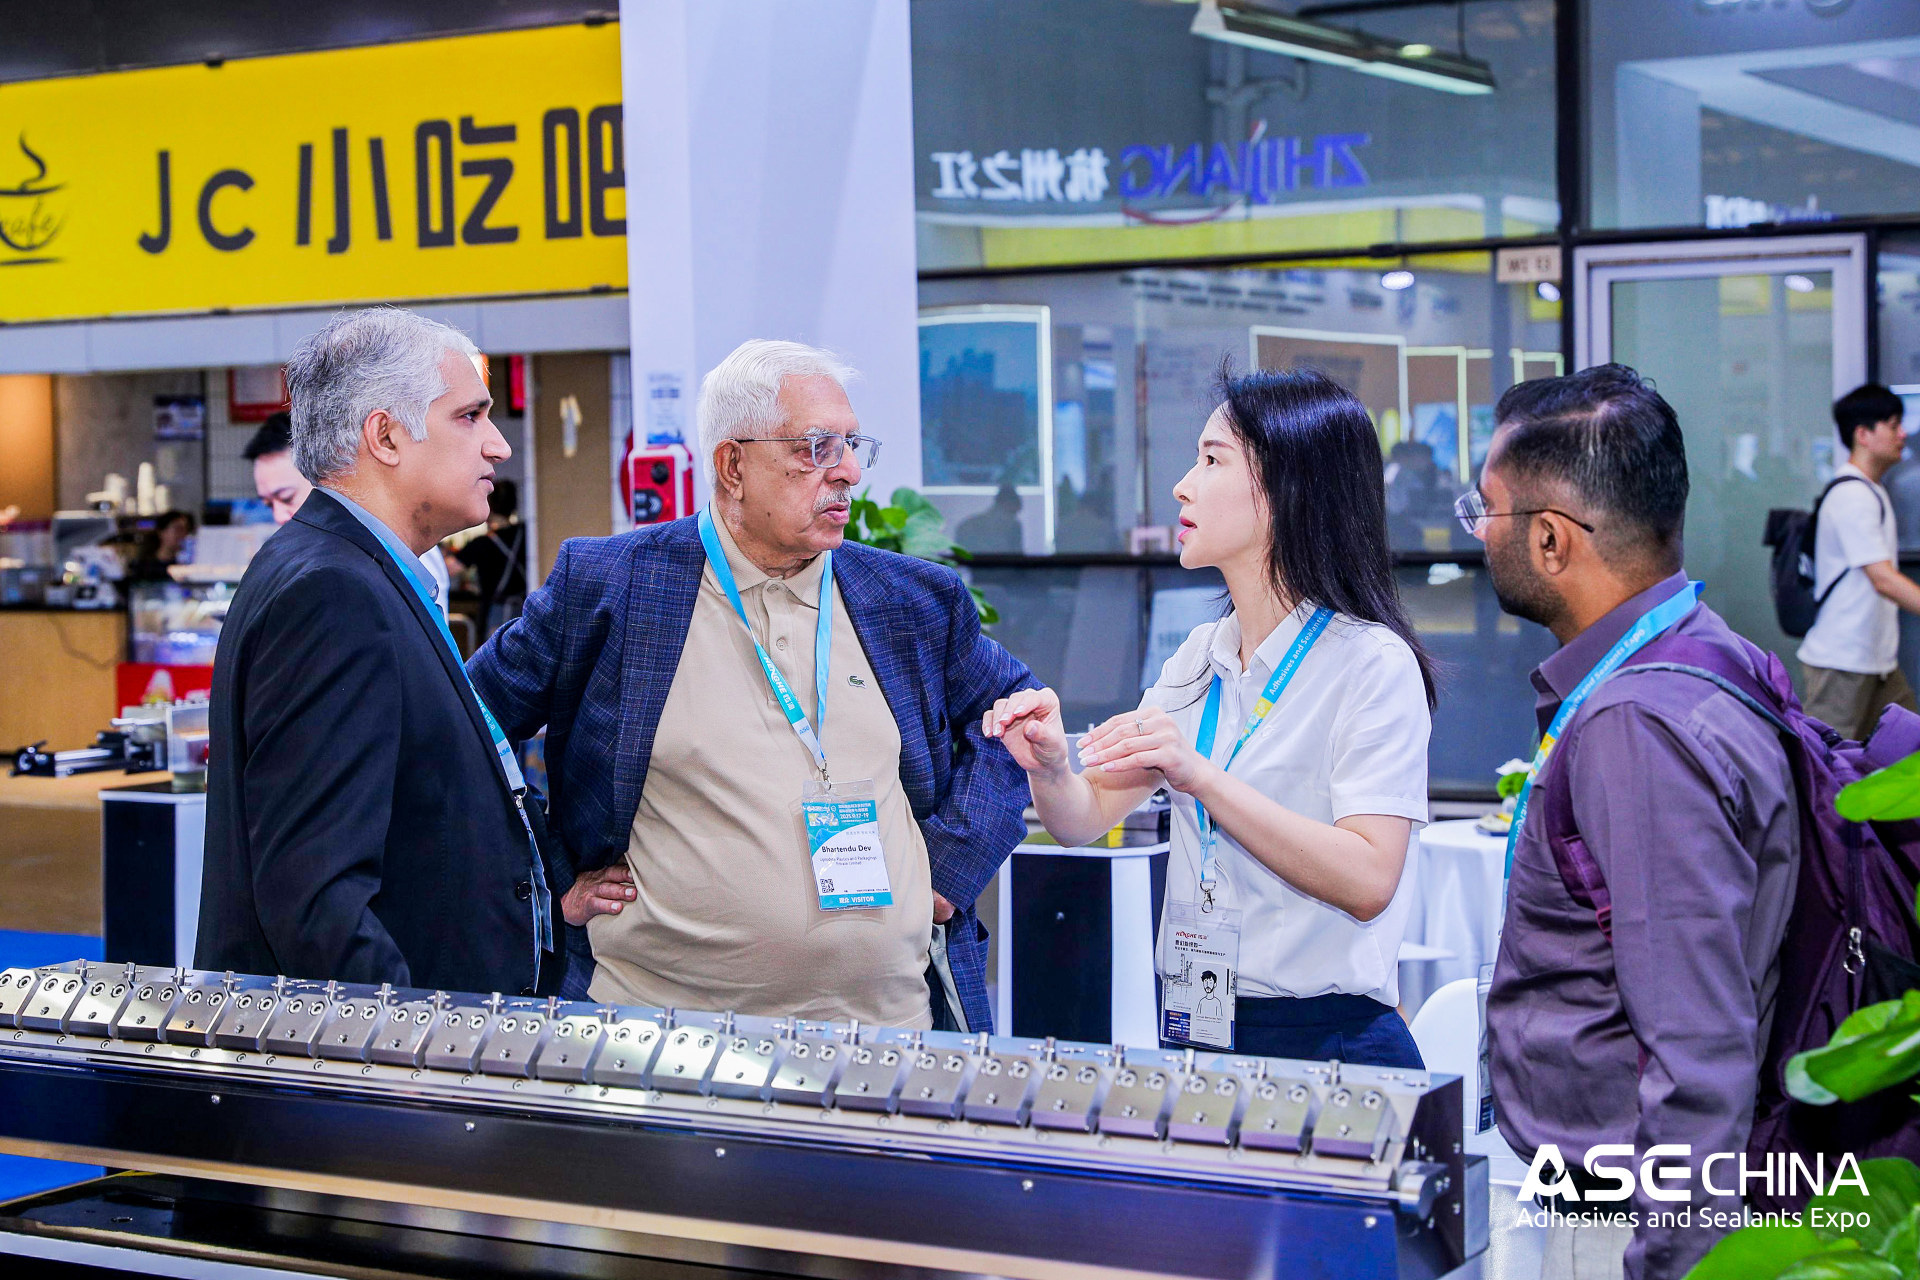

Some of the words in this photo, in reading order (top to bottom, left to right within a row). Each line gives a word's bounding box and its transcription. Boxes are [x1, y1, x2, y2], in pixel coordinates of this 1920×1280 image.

[295, 103, 627, 255] 小吃吧
[763, 656, 788, 694] HENGHE
[1269, 659, 1295, 695] Adhesives
[1292, 644, 1304, 659] and
[1300, 616, 1324, 645] Sealants
[1556, 694, 1583, 734] Adhesives
[1581, 677, 1596, 695] and
[1594, 646, 1626, 680] Sealants
[1623, 628, 1645, 648] Expo
[821, 845, 857, 853] Bhartendu
[857, 844, 872, 852] Dev
